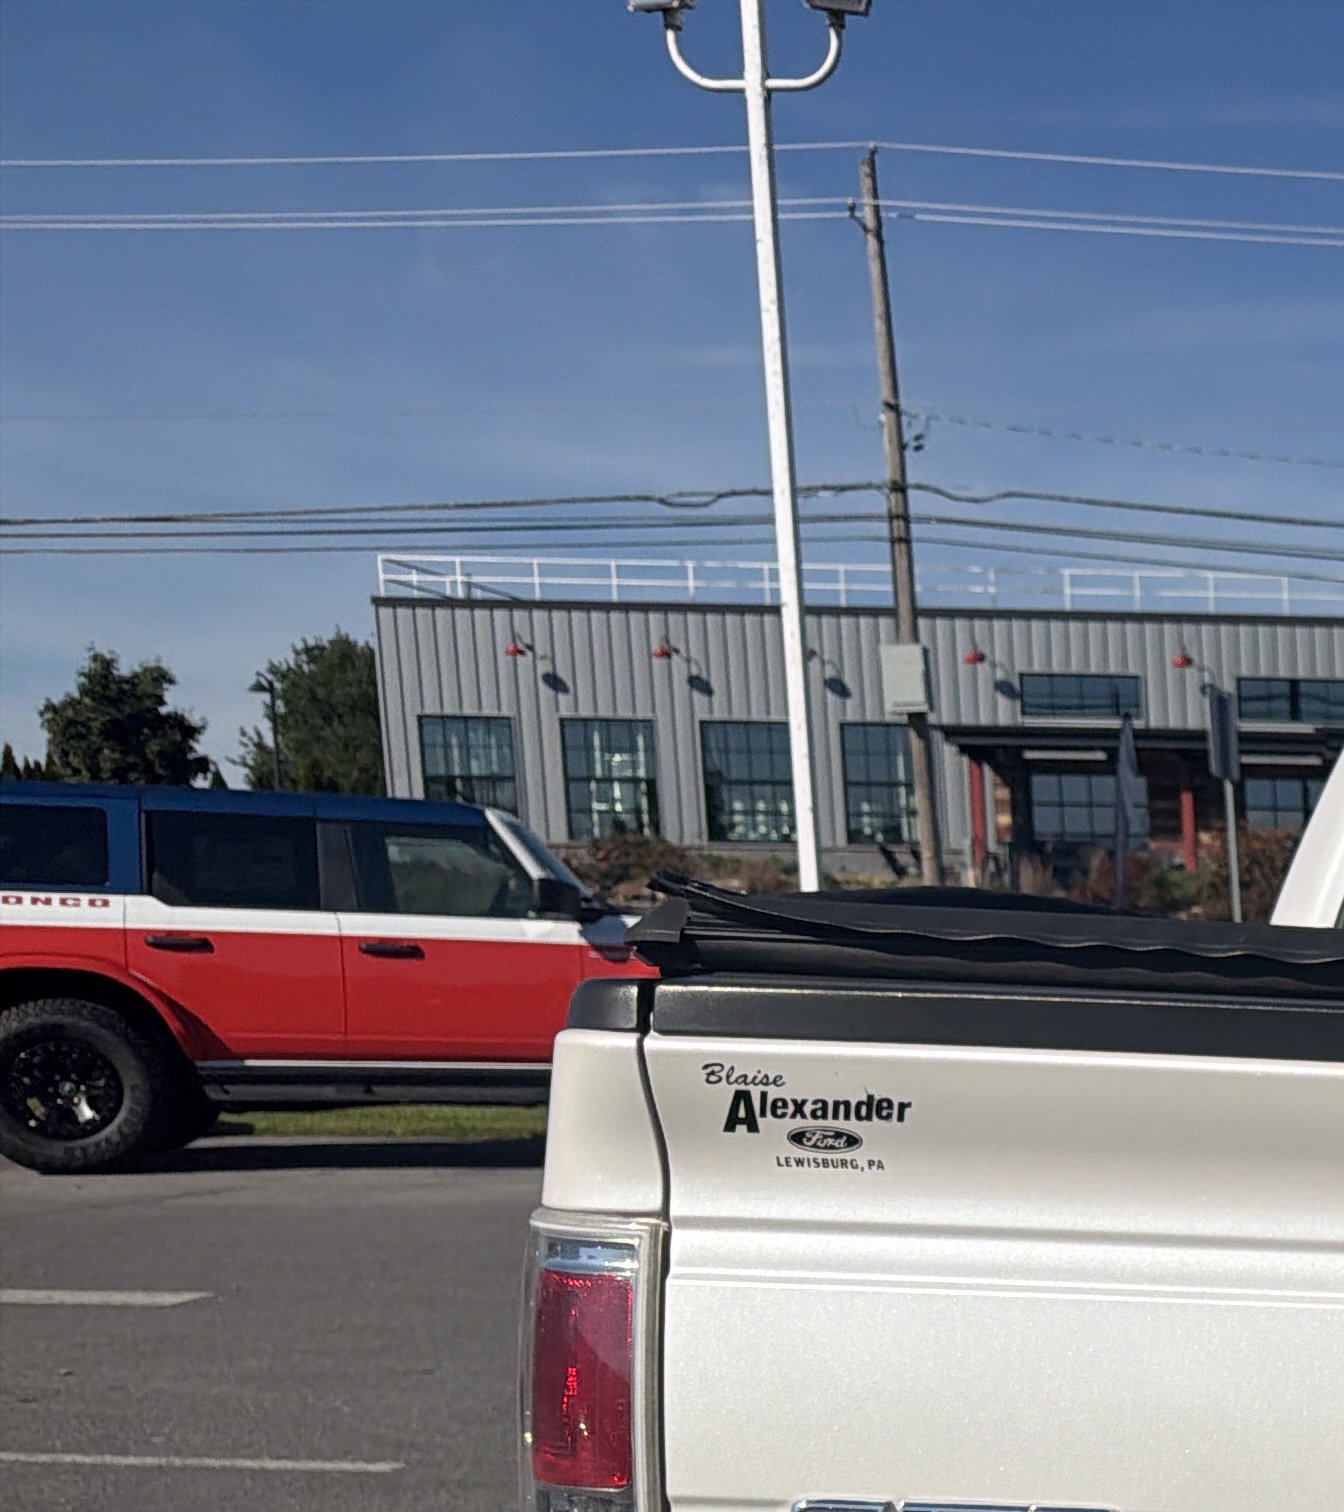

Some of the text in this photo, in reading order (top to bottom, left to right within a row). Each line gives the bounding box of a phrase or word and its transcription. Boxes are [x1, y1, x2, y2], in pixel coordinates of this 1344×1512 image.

[702, 1063, 785, 1087] Blaise
[723, 1090, 912, 1133] Alexander
[802, 1131, 848, 1148] Ford
[776, 1156, 885, 1172] LEWISBURG, PA
